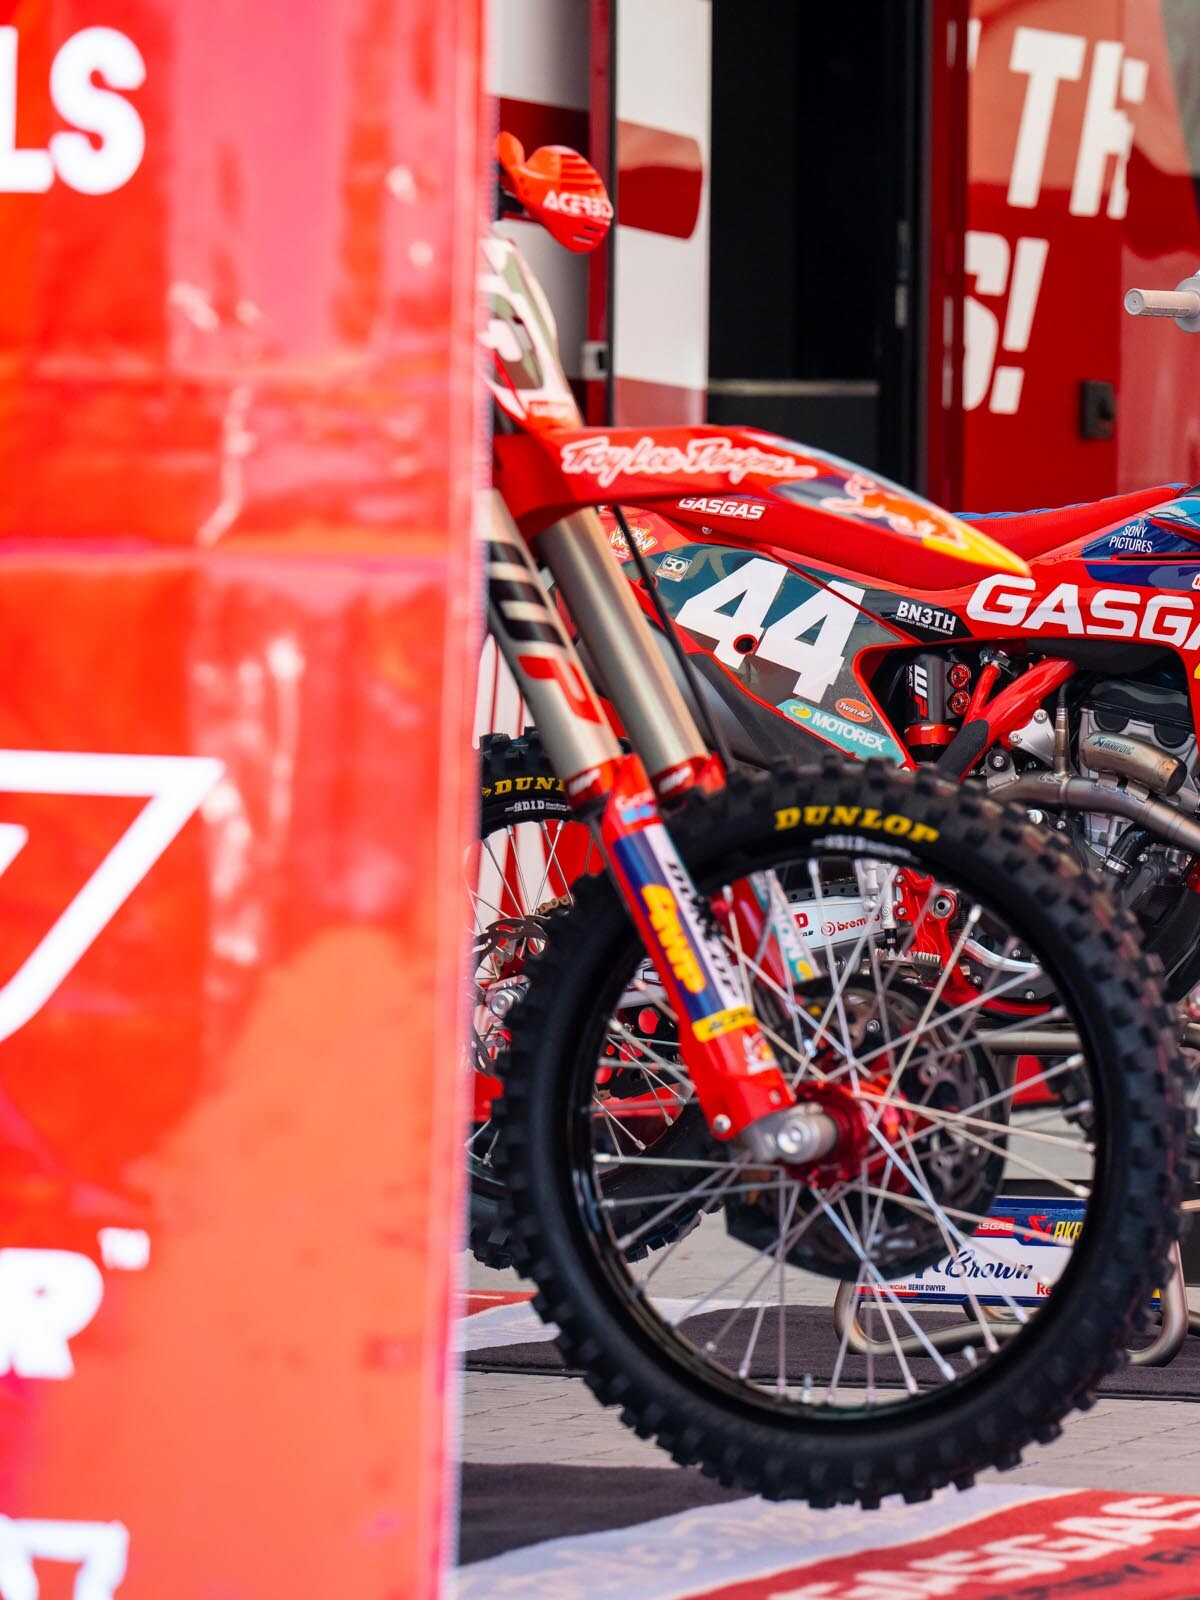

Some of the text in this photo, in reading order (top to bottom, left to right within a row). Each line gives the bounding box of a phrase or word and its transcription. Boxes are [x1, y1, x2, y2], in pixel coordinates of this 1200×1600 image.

[561, 436, 626, 488] Troy
[623, 436, 688, 474] Lee
[678, 497, 766, 520] GASGAS
[1109, 535, 1153, 553] PICTURES
[1122, 525, 1148, 538] SONY
[896, 600, 956, 632] BN3TH
[675, 556, 866, 704] 44
[838, 701, 870, 719] Twin Air
[811, 711, 887, 752] MOTOREX
[494, 777, 565, 795] DUN
[774, 805, 939, 843] DUNLOP
[945, 1249, 1034, 1281] Brown
[908, 1283, 925, 1291] DERIK
[925, 1283, 946, 1292] DWYER
